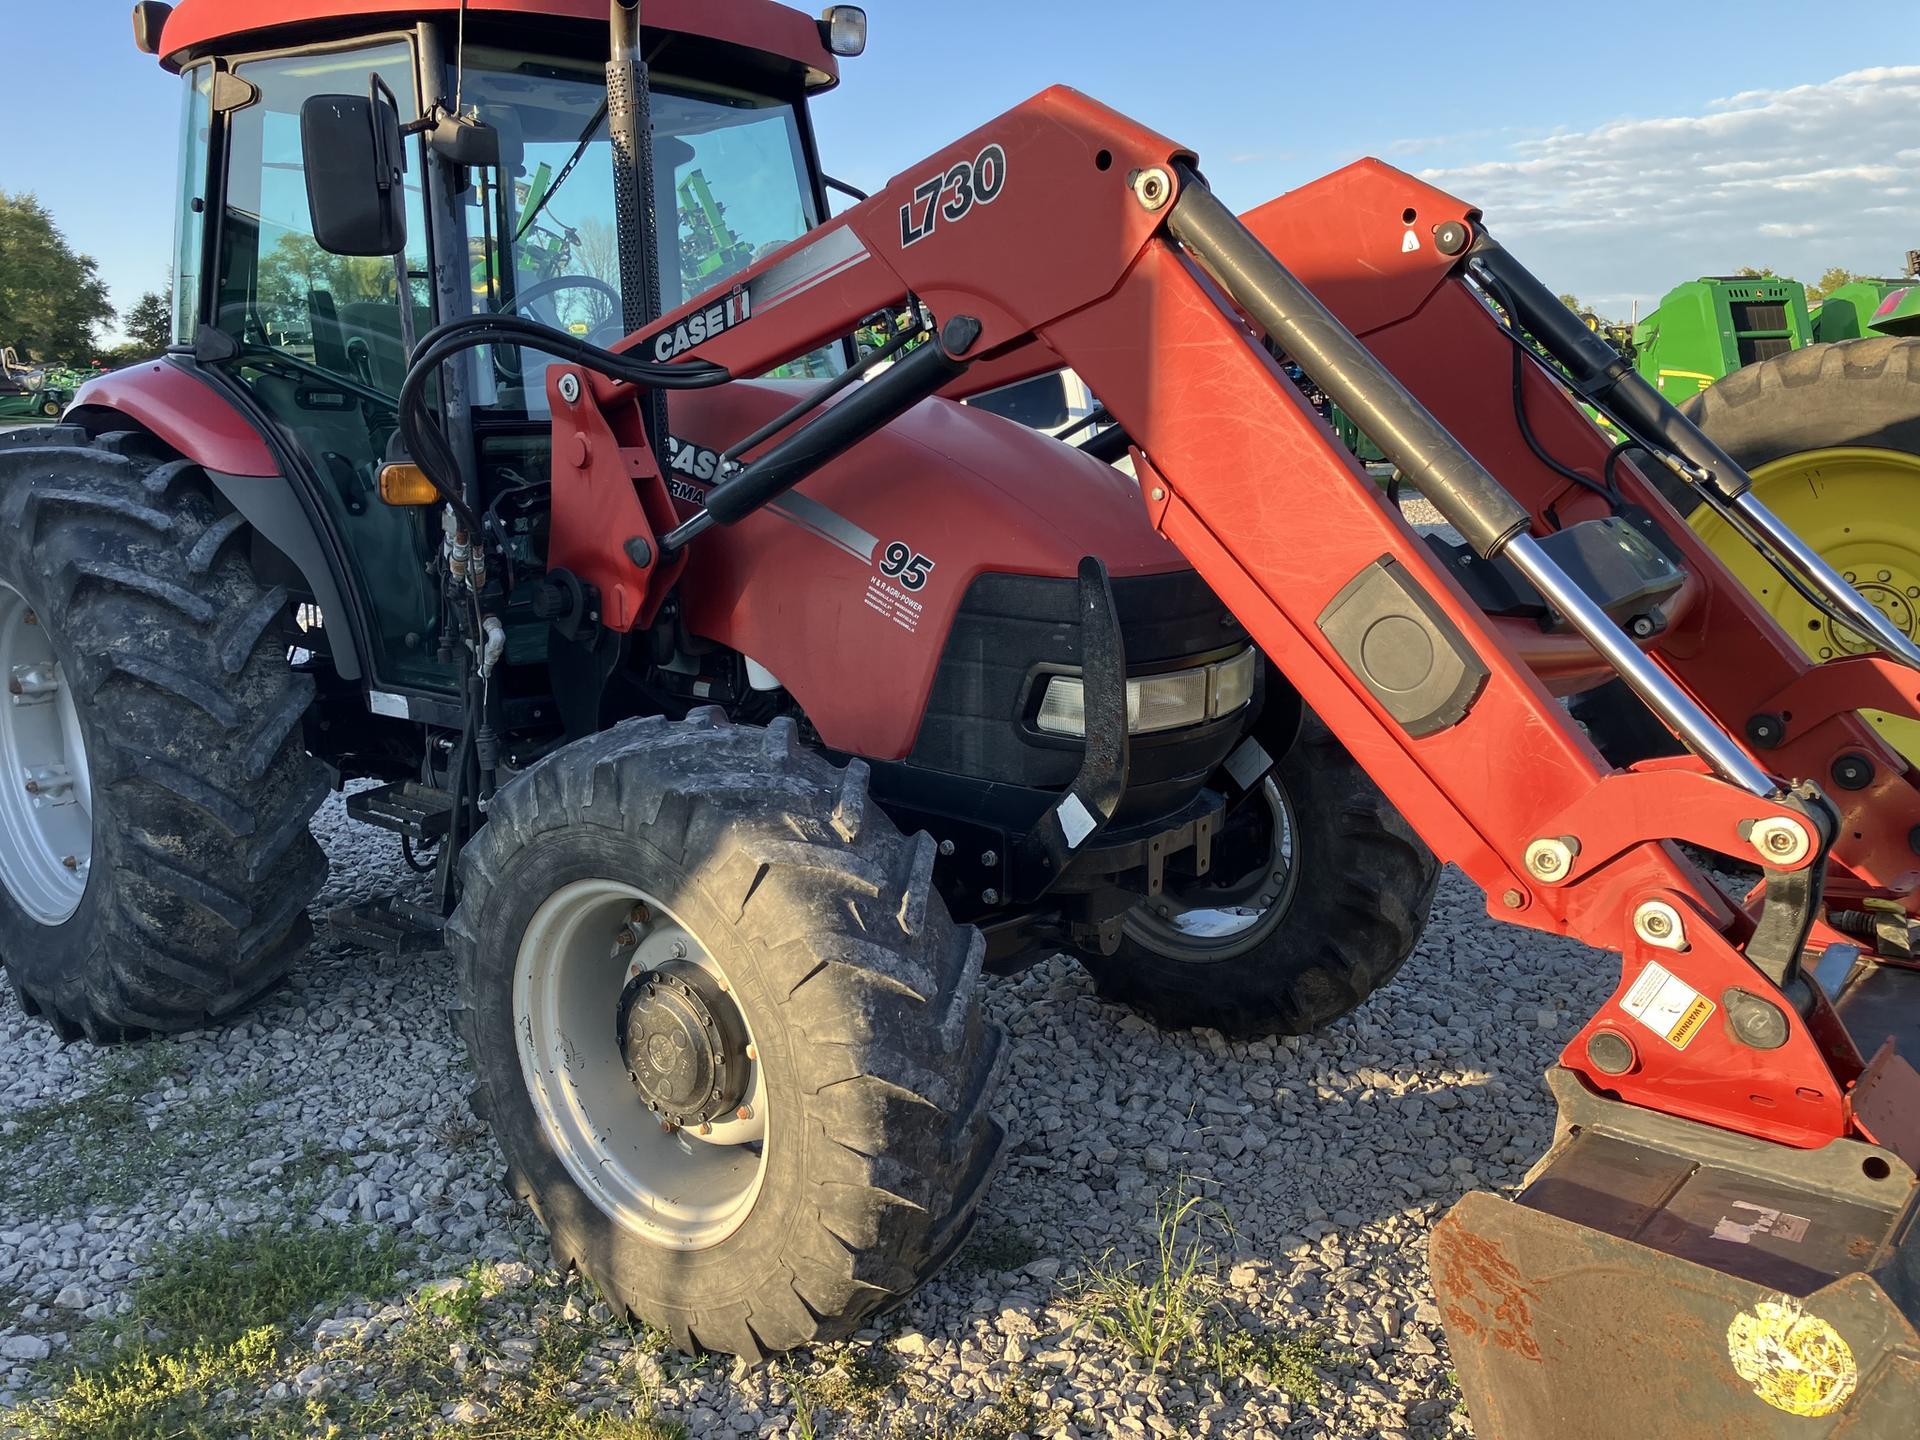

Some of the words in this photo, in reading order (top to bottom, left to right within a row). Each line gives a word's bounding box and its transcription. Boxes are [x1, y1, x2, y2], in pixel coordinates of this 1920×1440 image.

[899, 143, 1006, 249] L730
[655, 304, 724, 361] CASE
[879, 541, 935, 592] 95
[885, 586, 923, 612] AGRI-POWER
[1672, 1008, 1702, 1042] WARNING
